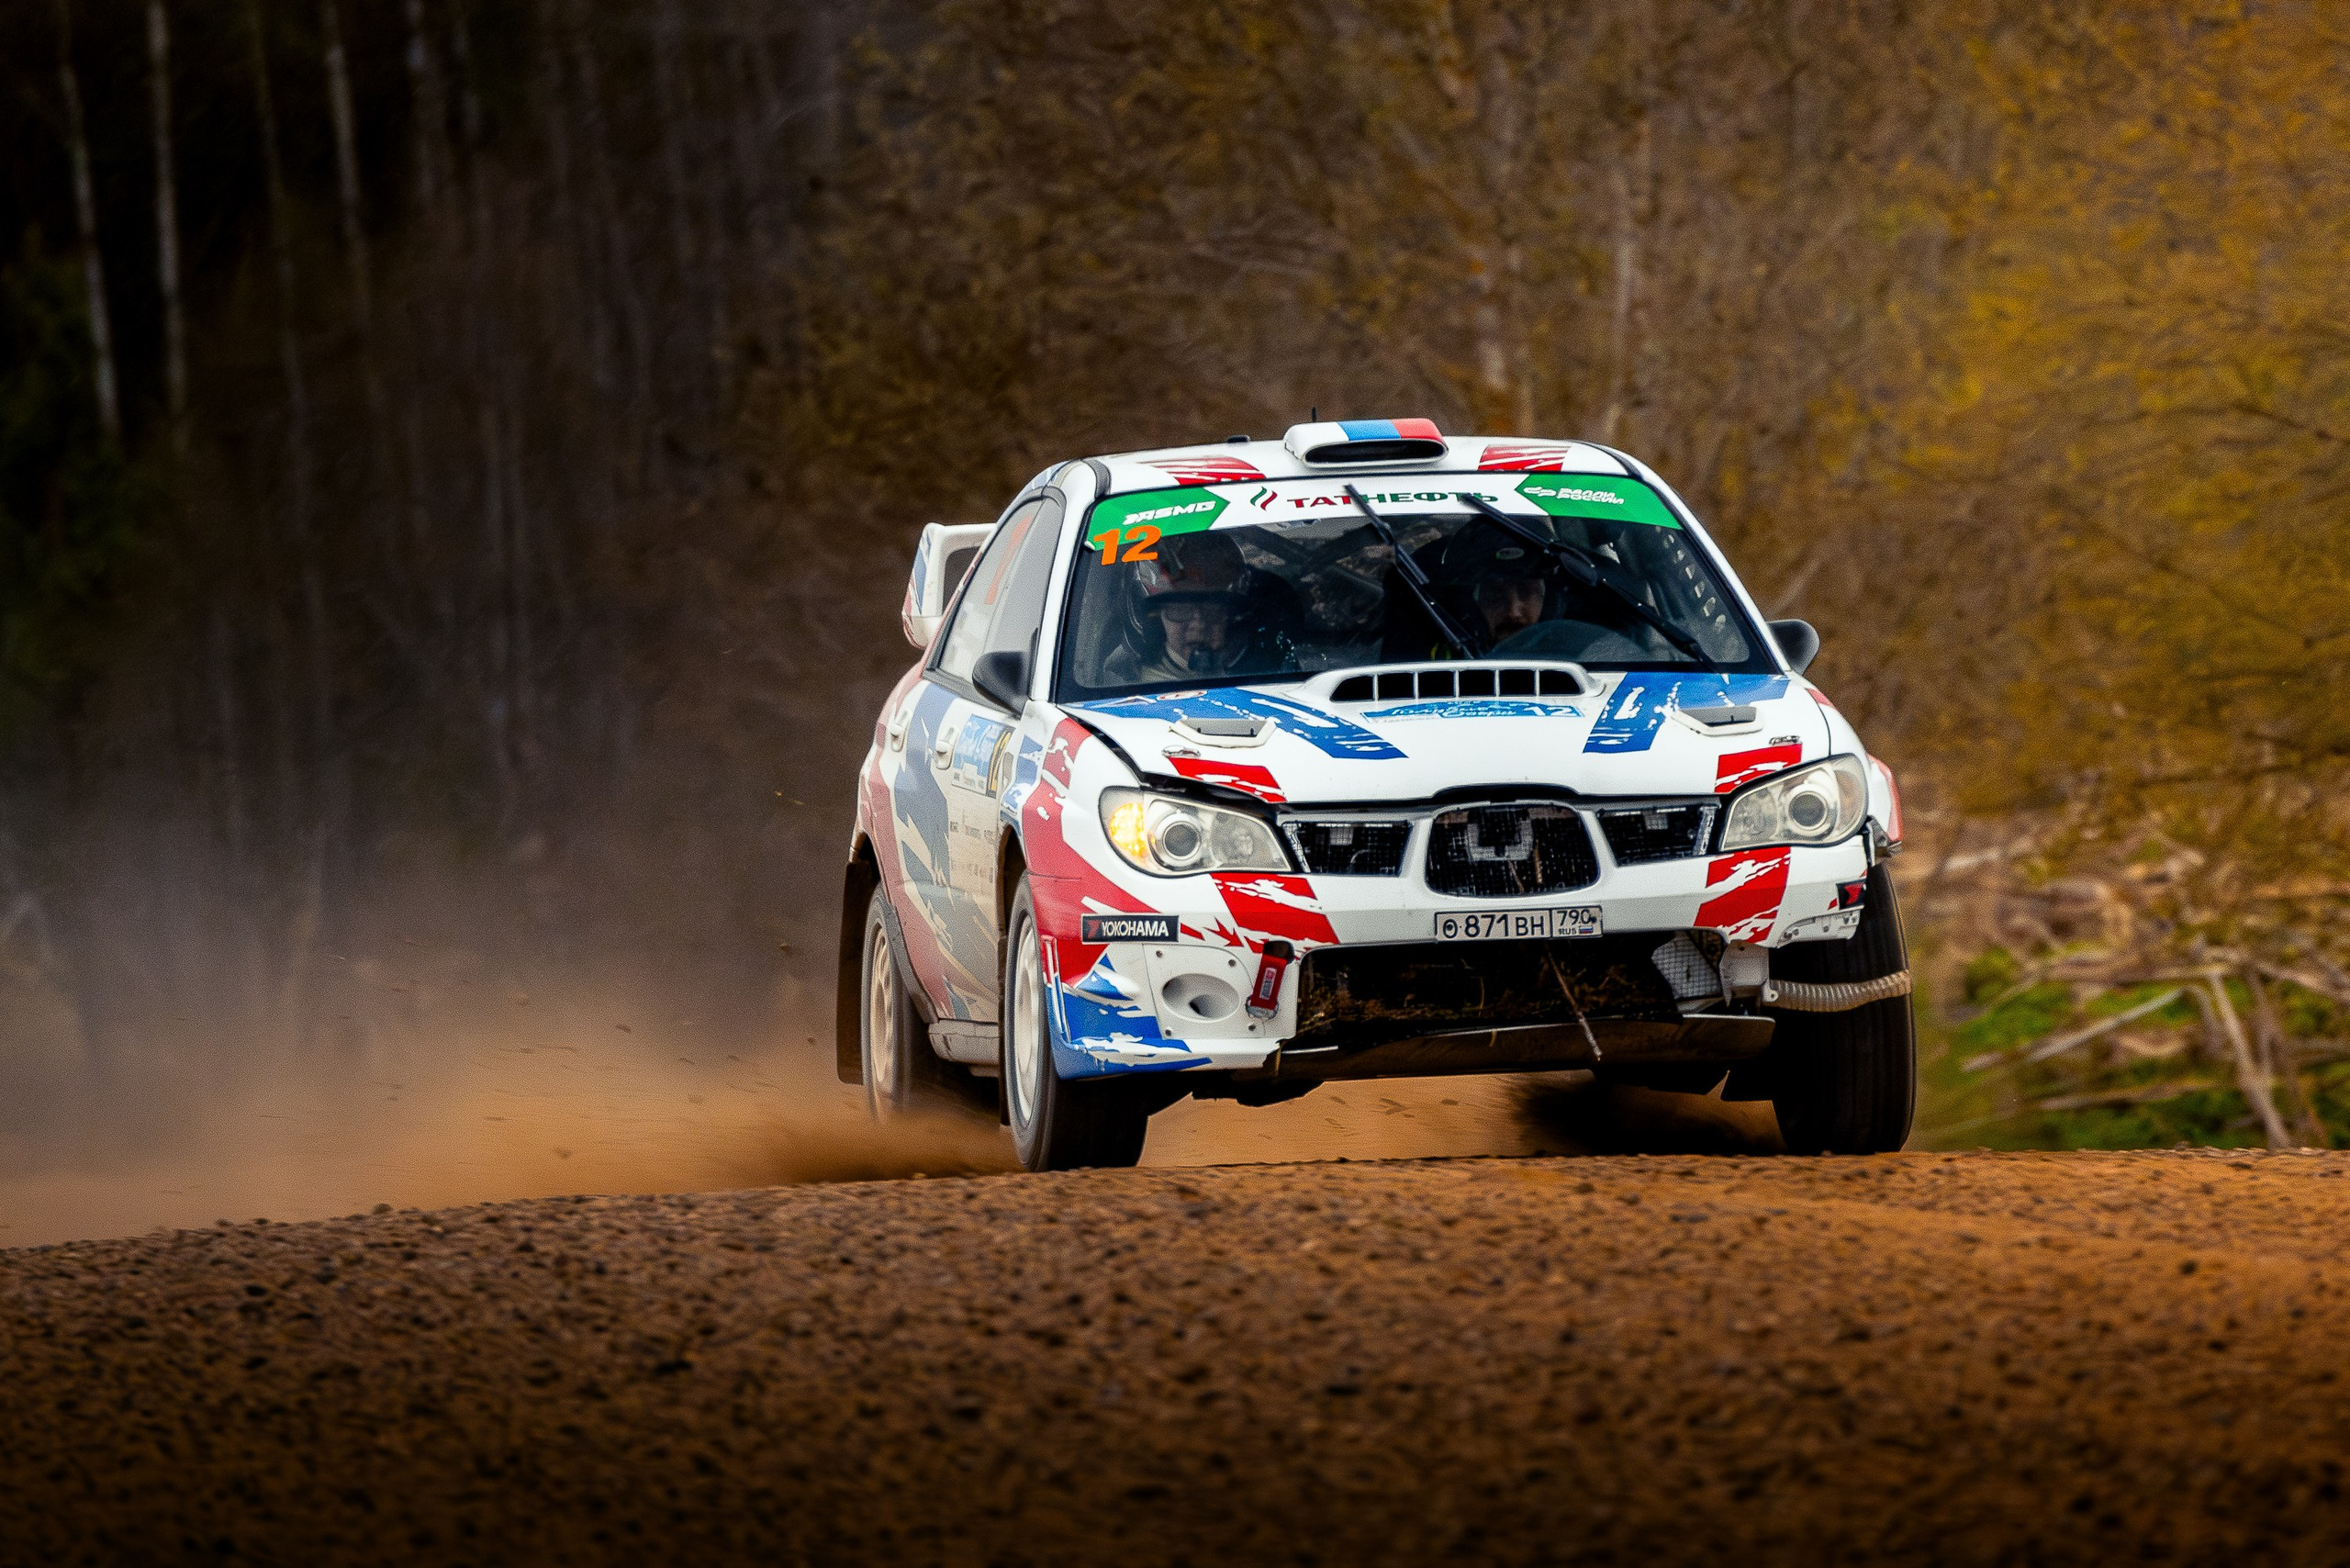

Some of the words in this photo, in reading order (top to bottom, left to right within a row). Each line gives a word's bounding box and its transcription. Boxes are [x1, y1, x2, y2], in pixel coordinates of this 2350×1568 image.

[1287, 492, 1498, 508] ТАТНЕФТЬ
[1093, 524, 1161, 566] 12
[1524, 706, 1578, 717] 12
[1557, 909, 1591, 926] 790
[1102, 921, 1169, 936] YOKOHAMA
[1558, 927, 1577, 935] RUS
